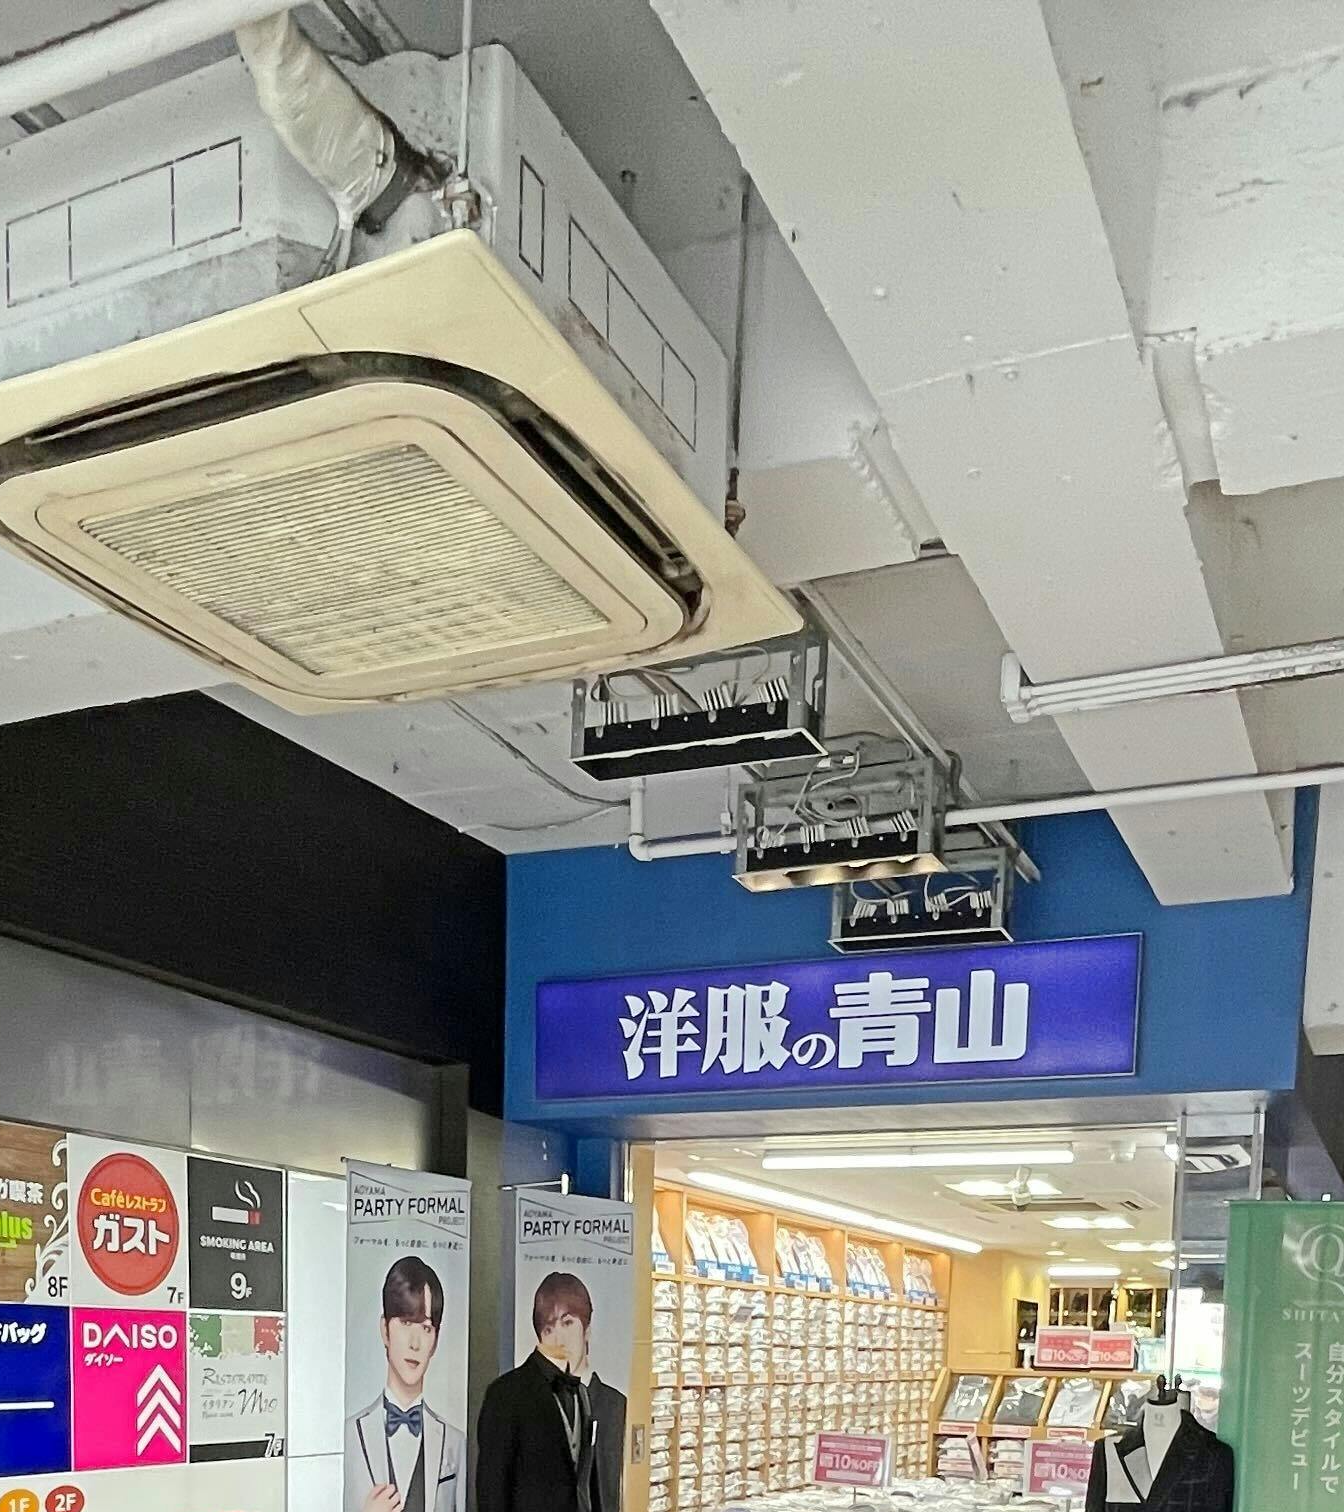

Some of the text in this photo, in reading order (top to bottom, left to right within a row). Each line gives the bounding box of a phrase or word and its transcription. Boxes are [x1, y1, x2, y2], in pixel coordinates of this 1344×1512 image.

[618, 969, 1029, 1079] 洋服の青山
[354, 1197, 465, 1216] PARTY FORMAL
[92, 1214, 170, 1255] ガスト
[524, 1219, 629, 1237] PARTY FORMAL
[200, 1235, 274, 1254] SMOKING AREA
[48, 1276, 68, 1297] 8F
[167, 1287, 184, 1304] 7F
[230, 1272, 253, 1300] 9F
[83, 1322, 178, 1349] DAISO
[84, 1352, 124, 1367] ダイソー
[1290, 1343, 1312, 1490] スーツデビュー
[55, 1493, 76, 1512] 2F
